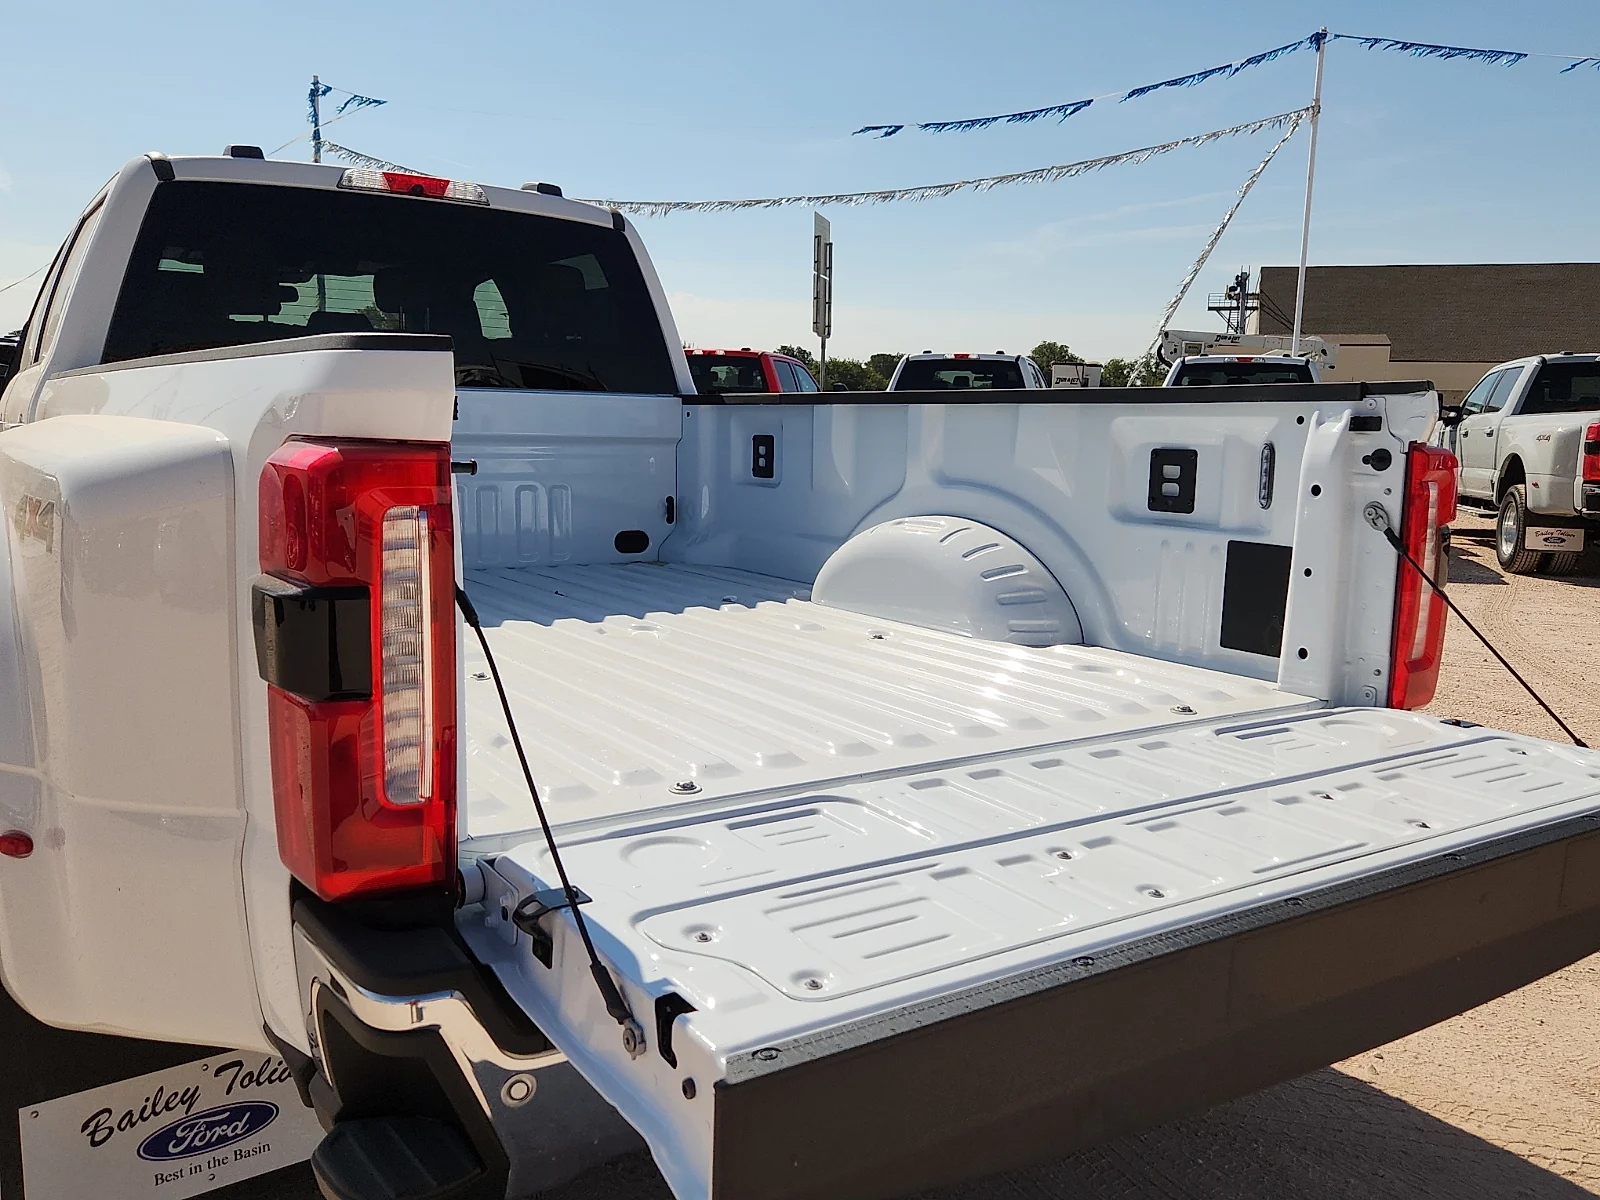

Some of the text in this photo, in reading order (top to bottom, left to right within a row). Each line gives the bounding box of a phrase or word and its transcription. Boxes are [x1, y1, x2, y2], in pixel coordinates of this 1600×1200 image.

[80, 1085, 201, 1148] Bailey
[168, 1112, 251, 1154] Ford
[154, 1142, 271, 1187] Best in the Basin
